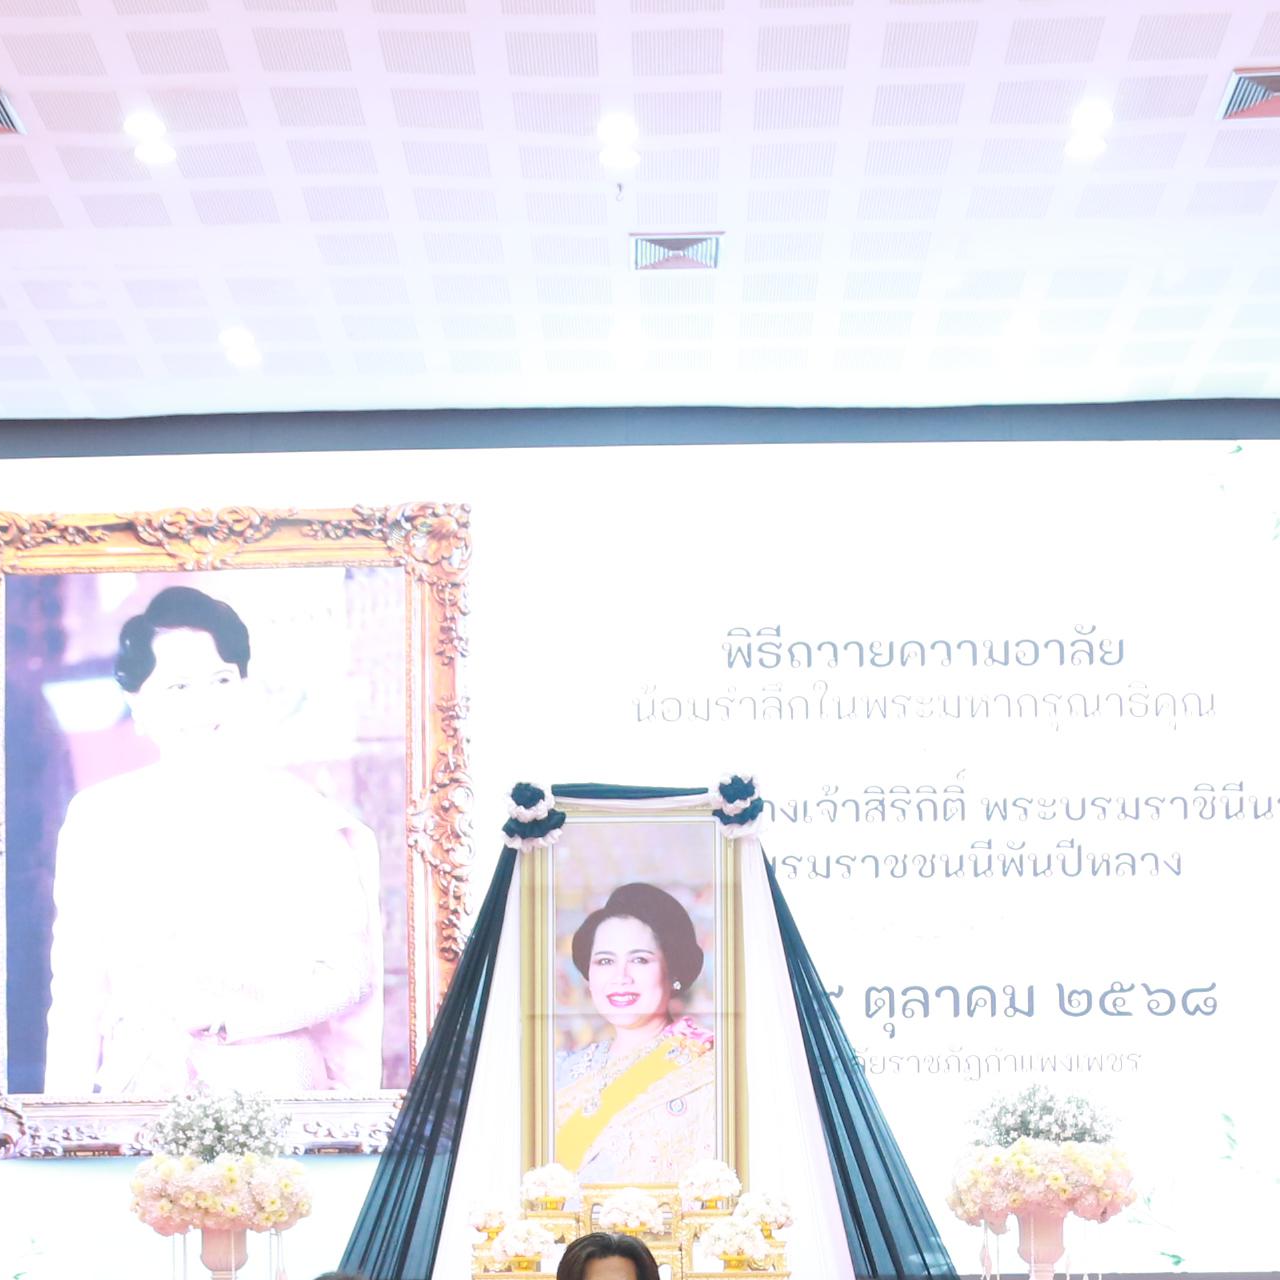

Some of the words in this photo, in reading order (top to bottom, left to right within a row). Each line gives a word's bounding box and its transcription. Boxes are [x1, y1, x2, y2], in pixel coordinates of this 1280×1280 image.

[721, 624, 1125, 669] พิธีถวายความอาลัย
[633, 680, 1216, 731] น้อมรำลึกในพระมหากรุณาธิคุณ
[864, 984, 1036, 1040] ตุลาคม
[1055, 980, 1218, 1018] ๒๕๖๘
